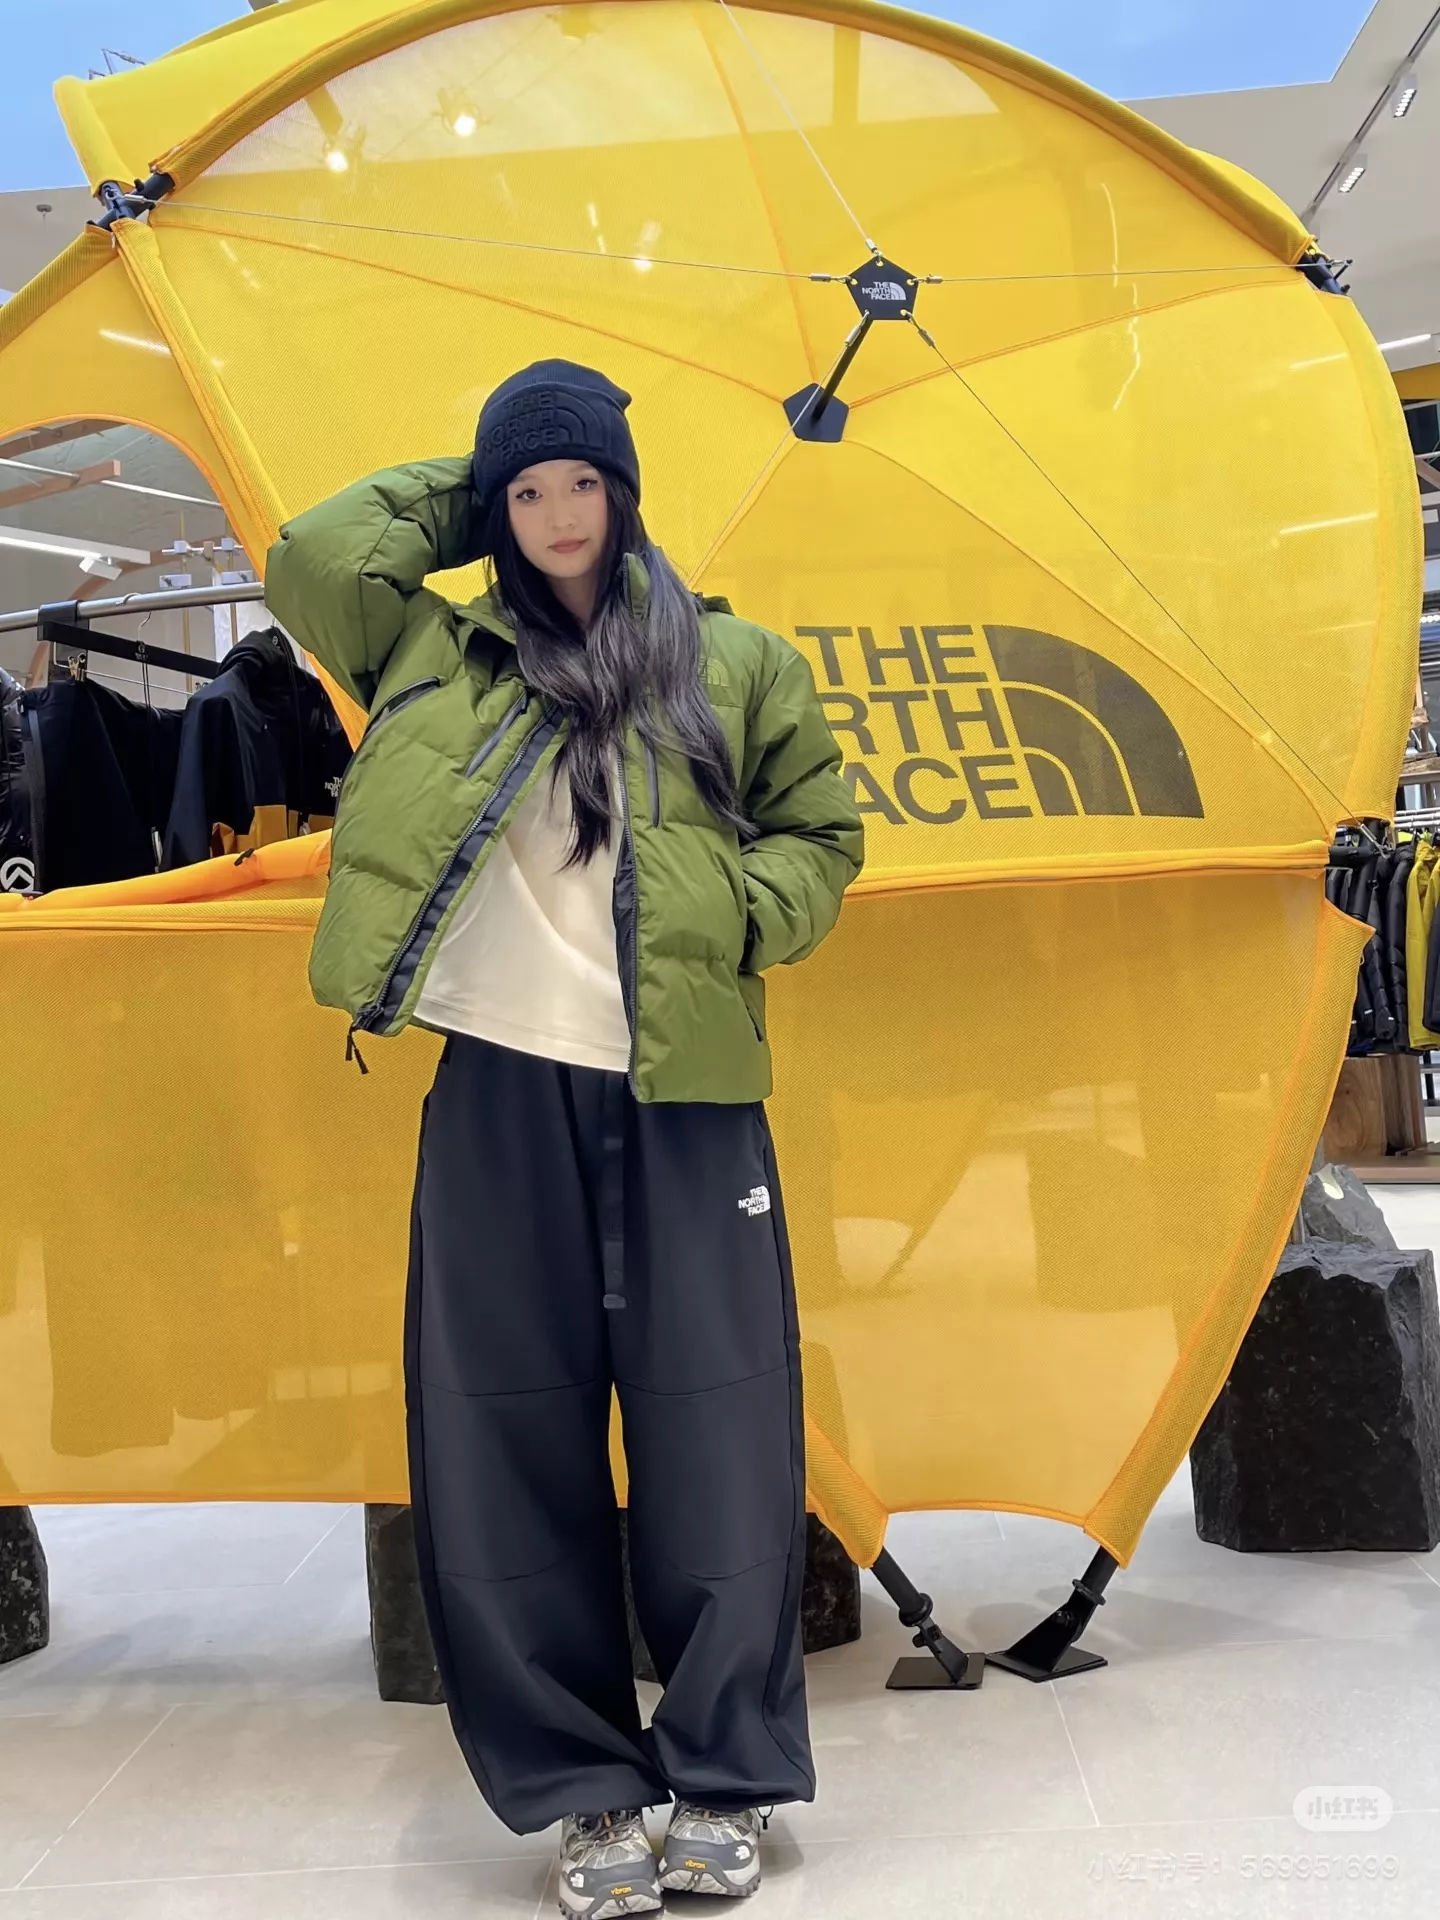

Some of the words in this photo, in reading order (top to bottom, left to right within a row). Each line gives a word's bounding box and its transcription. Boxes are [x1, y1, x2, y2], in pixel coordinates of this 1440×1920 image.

[862, 287, 891, 295] NORTH
[873, 281, 890, 289] THE
[504, 391, 555, 418] THE
[795, 625, 989, 686] THE
[817, 687, 1010, 756] RTH
[333, 776, 343, 784] TH
[843, 754, 1034, 825] ACE
[749, 1186, 764, 1198] THE
[737, 1195, 765, 1210] NORTH
[747, 1203, 765, 1217] FACE
